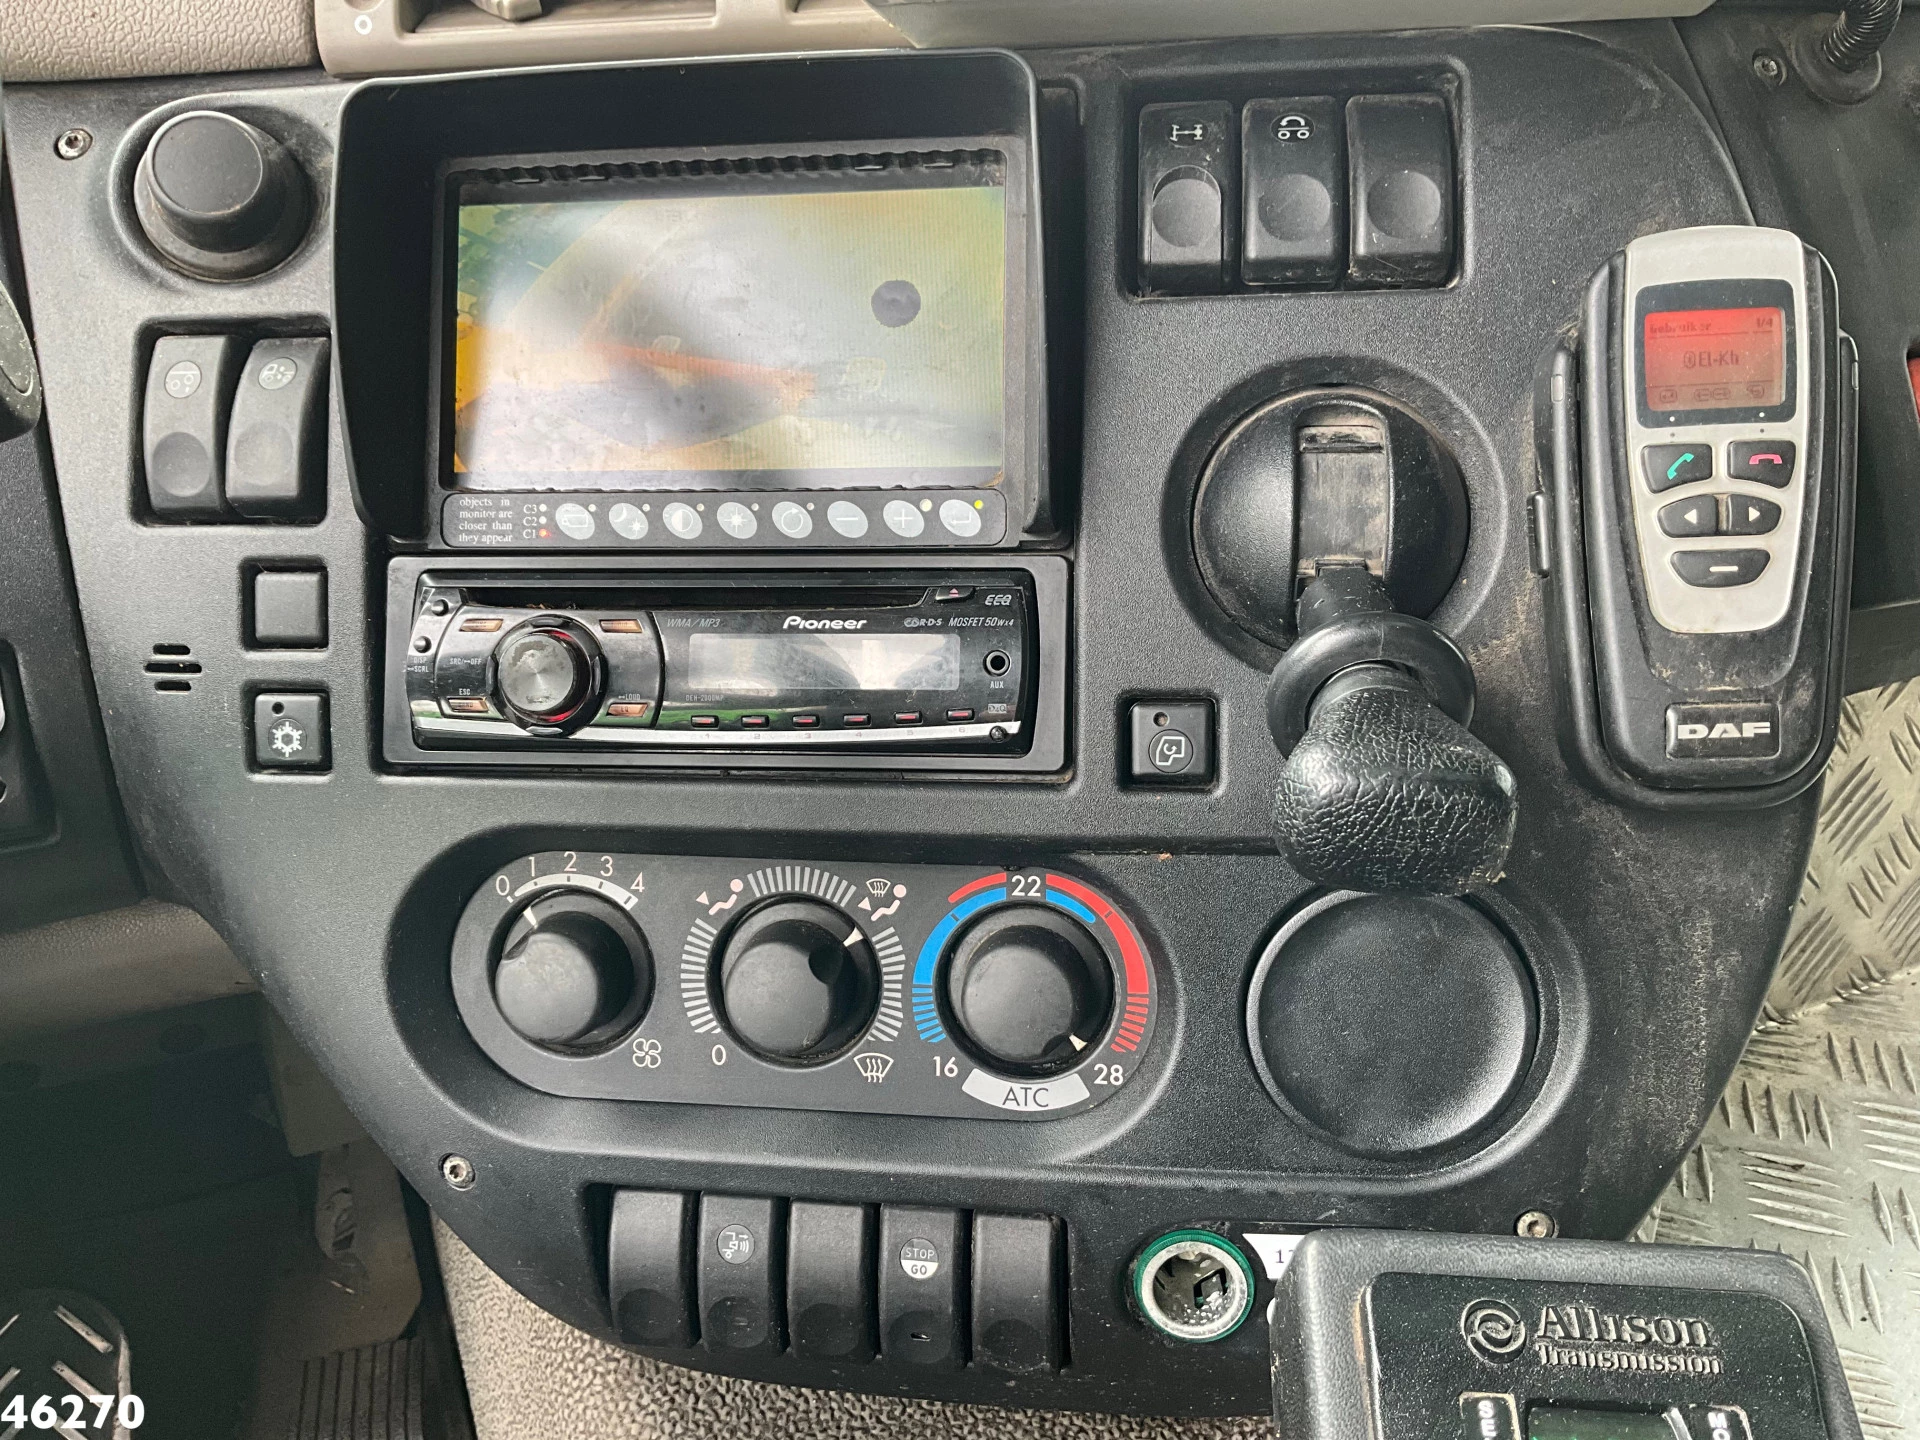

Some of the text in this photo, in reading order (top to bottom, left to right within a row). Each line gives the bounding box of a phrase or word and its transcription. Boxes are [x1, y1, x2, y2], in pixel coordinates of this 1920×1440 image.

[460, 497, 510, 509] objects in
[523, 504, 537, 514] C3
[460, 509, 513, 518] monitor are
[459, 521, 513, 530] closer than
[523, 517, 537, 526] C2
[459, 533, 513, 545] they appear
[523, 529, 536, 539] C1
[782, 615, 868, 630] Pioneer
[948, 617, 984, 627] MOSFET
[414, 665, 429, 673] SCRL
[990, 680, 1004, 689] AUX
[625, 693, 641, 701] LOUD
[1677, 721, 1771, 739] DAF
[528, 856, 536, 877] 1
[563, 851, 577, 872] 2
[600, 855, 614, 877] 3
[495, 875, 510, 896] 0
[630, 871, 645, 893] 4
[1011, 874, 1041, 897] 22
[711, 1044, 727, 1066] 0
[932, 1055, 959, 1078] 16
[1093, 1063, 1124, 1086] 28
[1002, 1086, 1049, 1108] ATC
[905, 1247, 935, 1260] STOP
[910, 1264, 928, 1275] GO
[1535, 1305, 1720, 1348] Allison
[1536, 1345, 1725, 1375] Transmission
